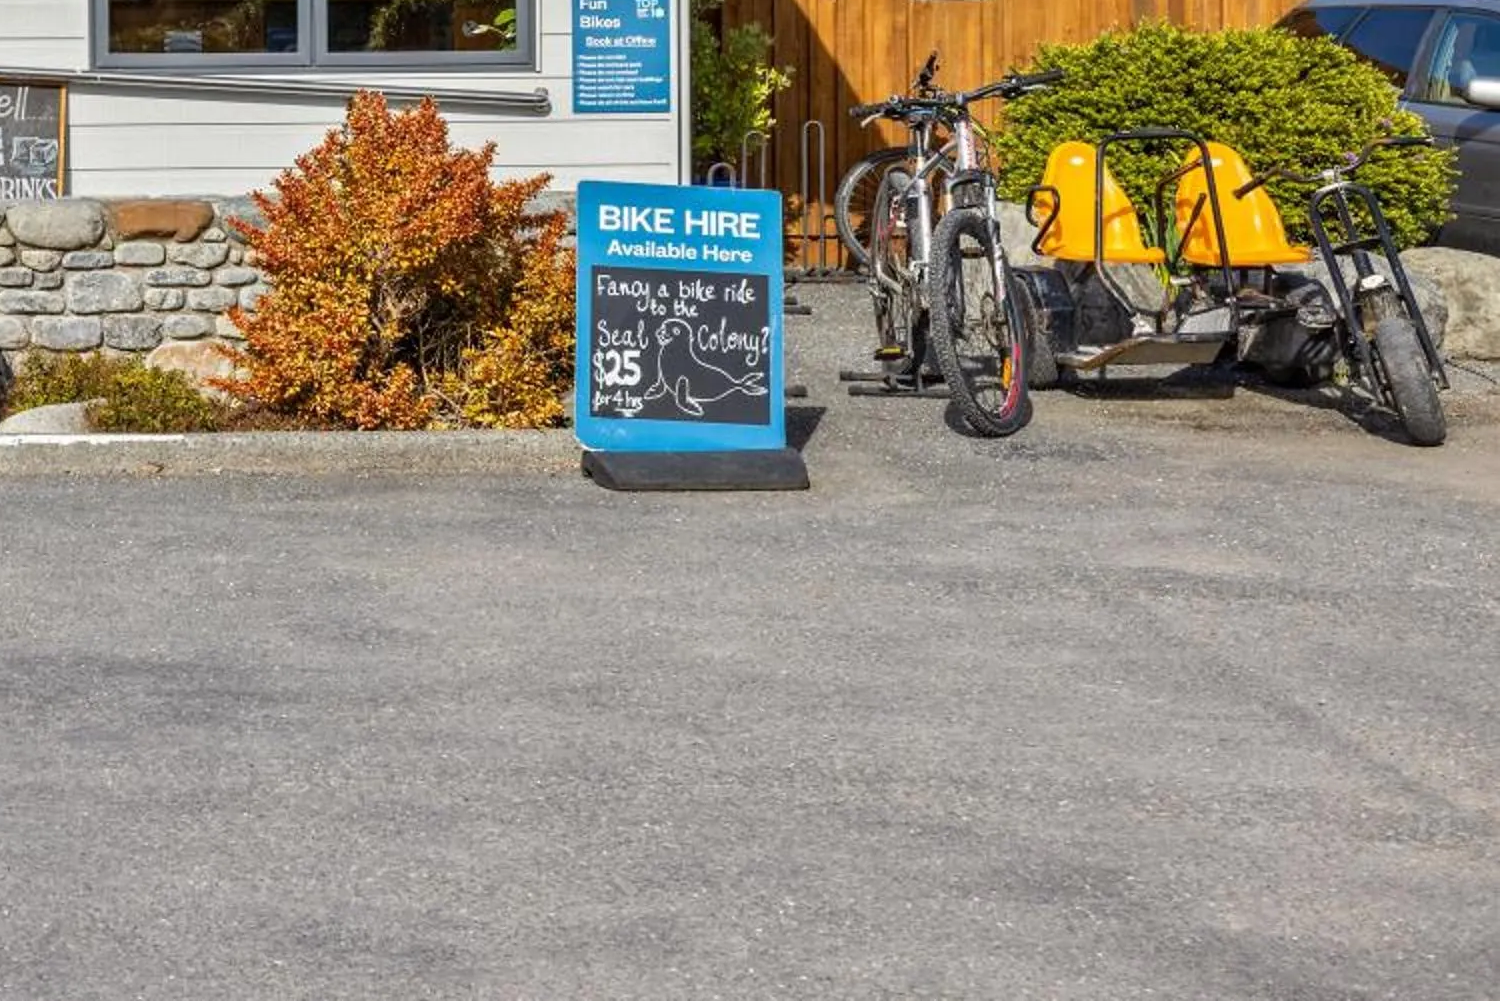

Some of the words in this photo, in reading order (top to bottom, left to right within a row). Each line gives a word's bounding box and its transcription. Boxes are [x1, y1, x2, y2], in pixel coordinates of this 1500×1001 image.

[579, 14, 621, 29] Bikes
[585, 35, 612, 48] Book
[598, 204, 675, 234] BIKE
[684, 209, 762, 240] HIRE
[606, 239, 697, 261] Available
[702, 244, 754, 263] Here
[596, 273, 651, 312] Fancy
[656, 282, 670, 299] a
[678, 278, 716, 301] bike
[723, 278, 757, 304] ride
[650, 297, 667, 317] to
[673, 299, 700, 318] the
[596, 318, 649, 350] Seal
[697, 316, 770, 366] Colony?
[592, 349, 643, 389] $25
